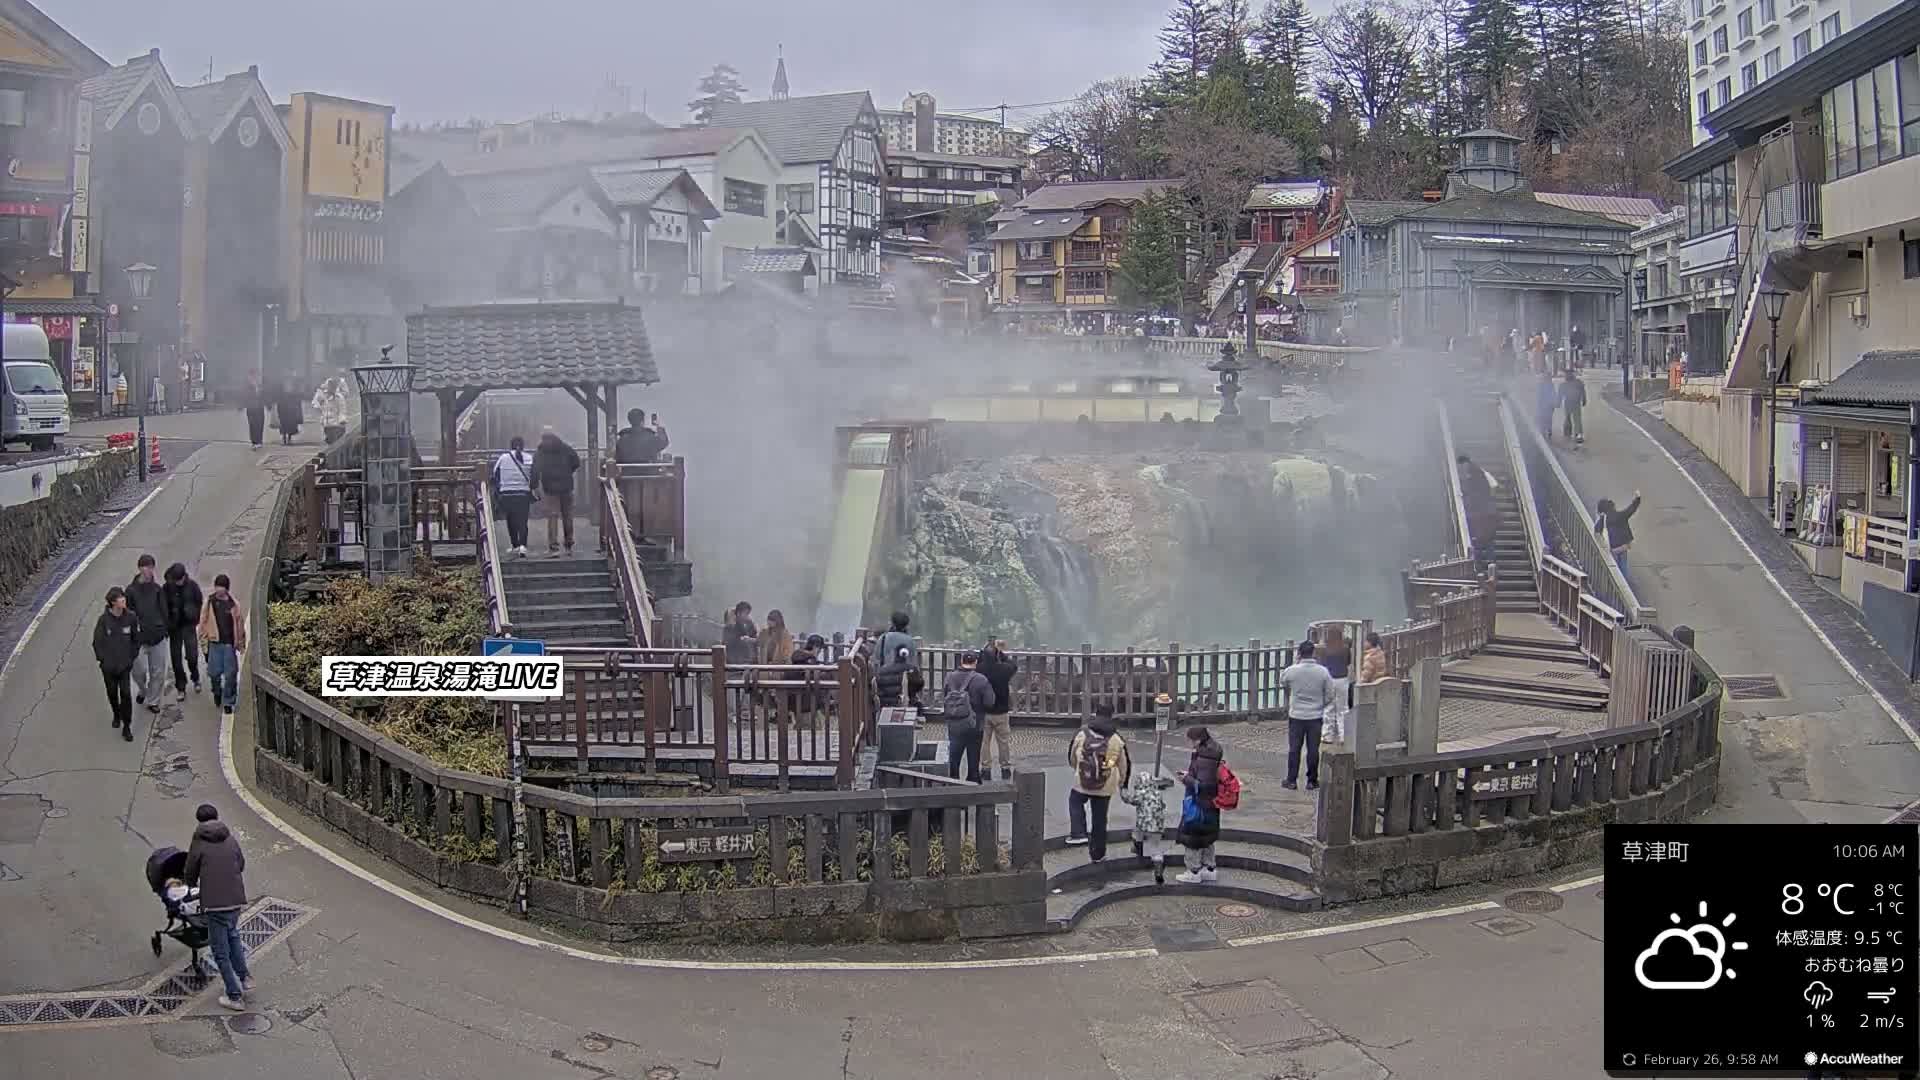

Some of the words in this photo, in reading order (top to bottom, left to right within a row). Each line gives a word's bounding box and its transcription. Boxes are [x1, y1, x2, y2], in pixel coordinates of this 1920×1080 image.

[685, 837, 712, 854] 東京
[715, 834, 754, 853] 軽井沢
